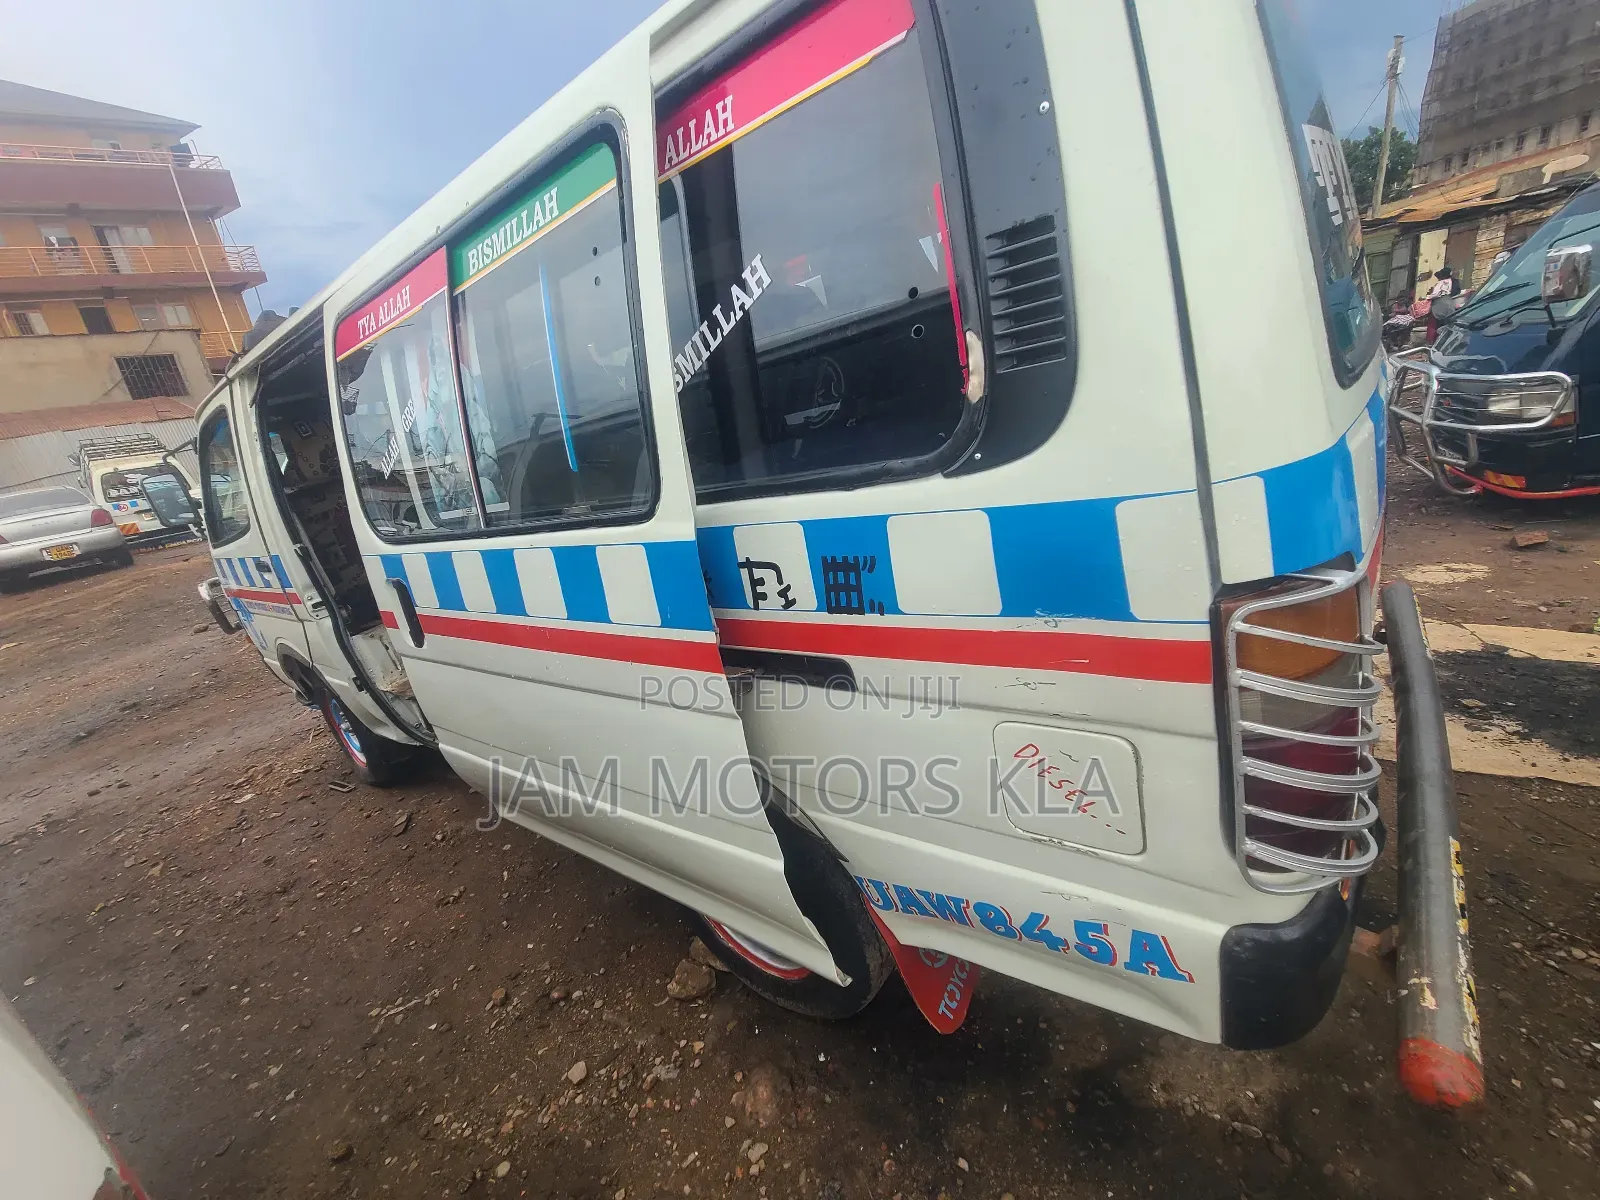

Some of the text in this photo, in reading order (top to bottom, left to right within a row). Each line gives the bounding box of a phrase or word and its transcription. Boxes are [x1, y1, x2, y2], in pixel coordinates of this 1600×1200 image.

[664, 95, 735, 170] ALLAH
[467, 187, 560, 276] BISMILLAH
[357, 285, 411, 339] TYA ALLAH
[674, 254, 772, 393] SMILLAH
[381, 435, 400, 480] ALLAH
[938, 957, 970, 1020] TOYO
